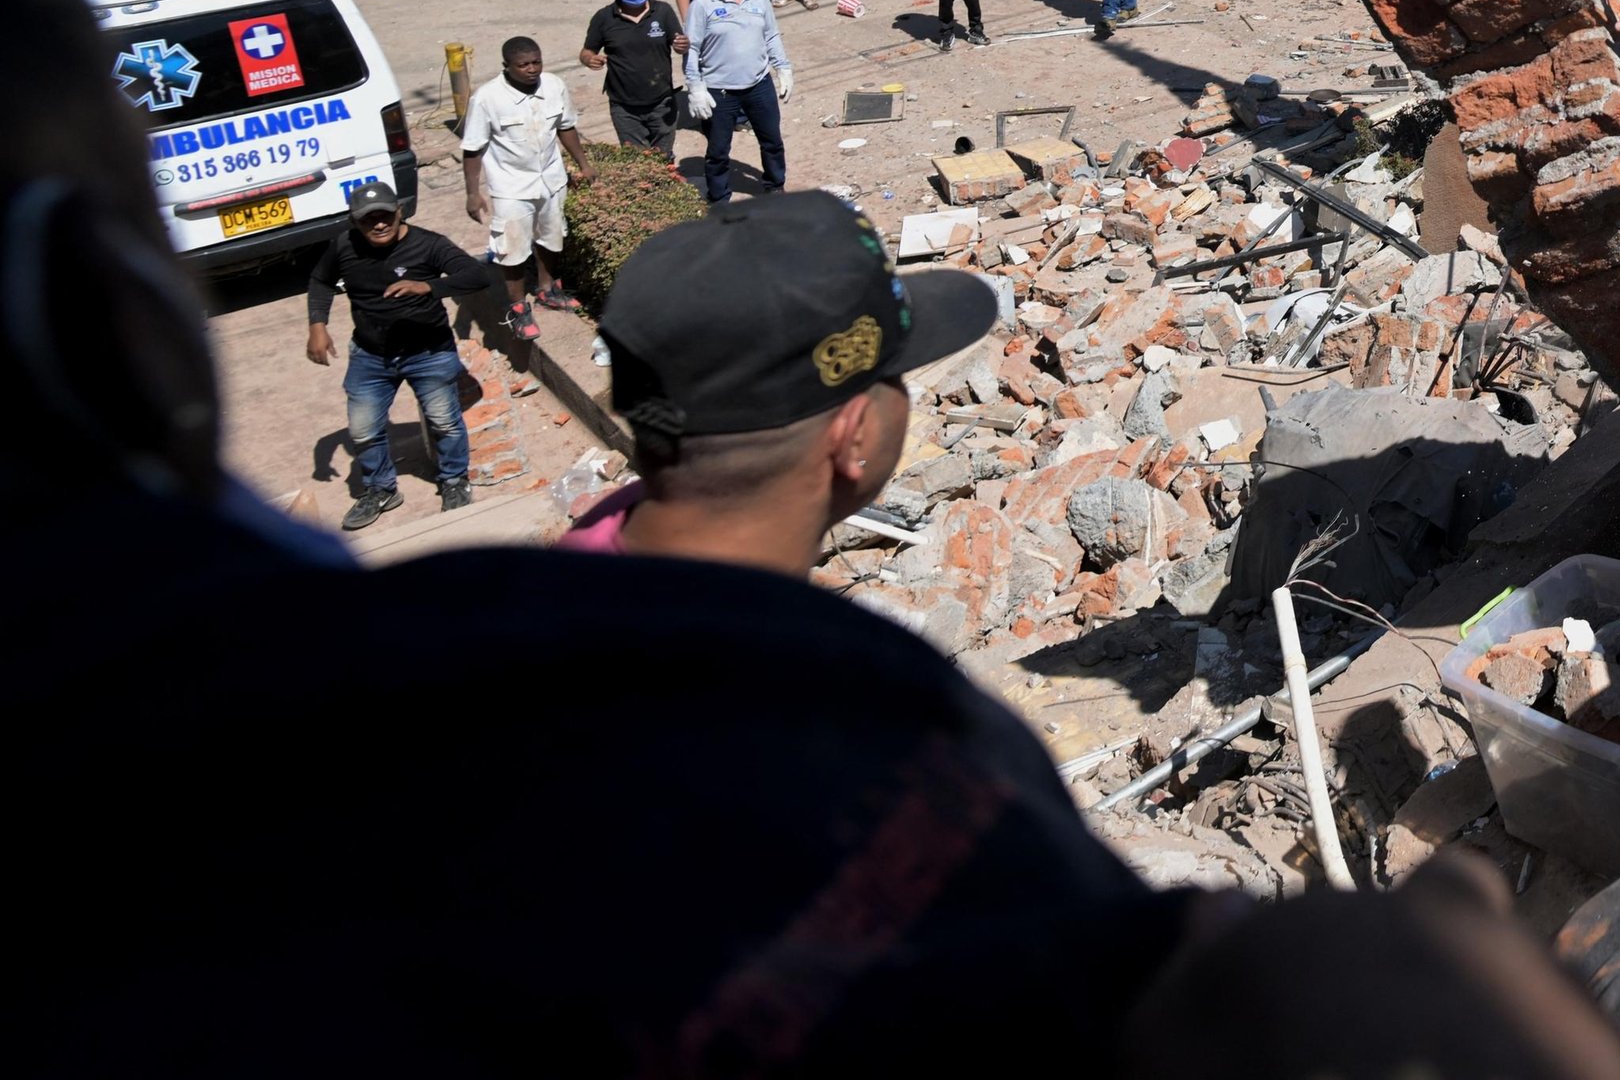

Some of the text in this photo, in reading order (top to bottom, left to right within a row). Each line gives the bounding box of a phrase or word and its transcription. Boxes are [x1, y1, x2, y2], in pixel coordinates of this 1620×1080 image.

[248, 64, 297, 81] MISION
[248, 73, 301, 91] MEDICA
[150, 99, 352, 160] MBULANCIA
[177, 137, 320, 183] 315 366 19 79
[223, 200, 289, 230] DCM 569
